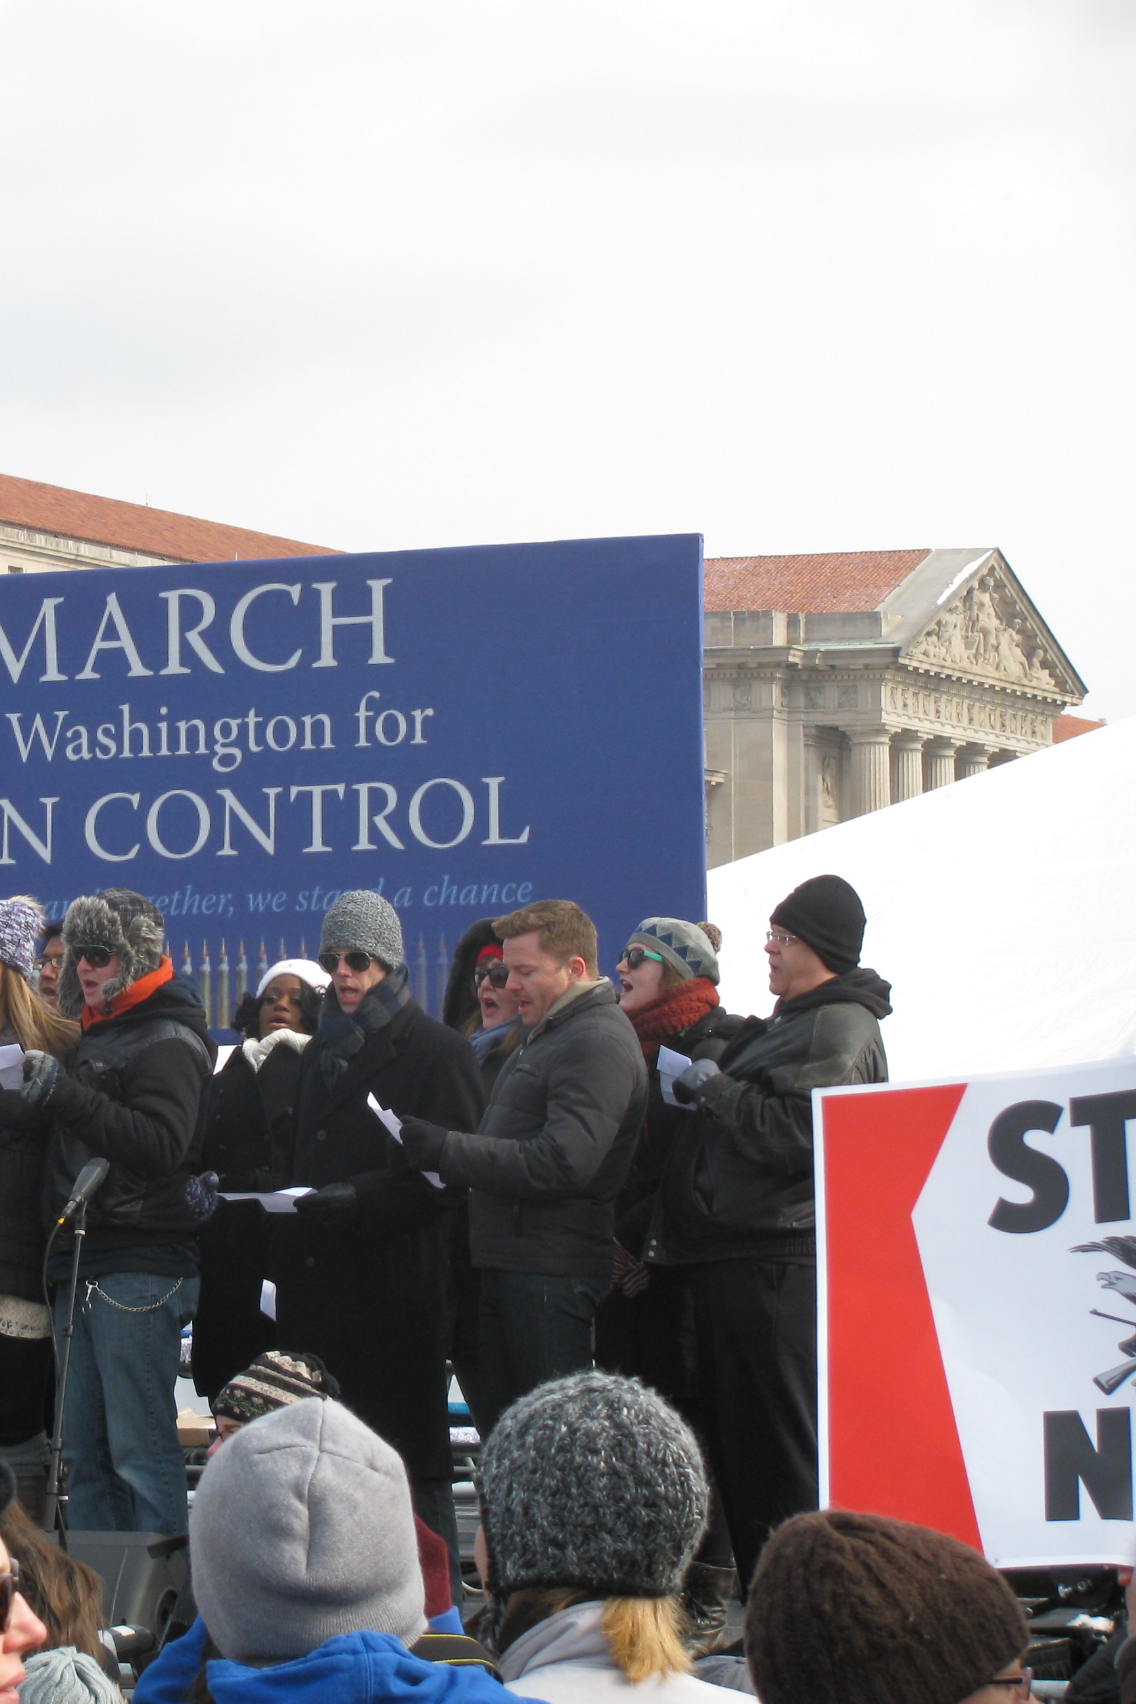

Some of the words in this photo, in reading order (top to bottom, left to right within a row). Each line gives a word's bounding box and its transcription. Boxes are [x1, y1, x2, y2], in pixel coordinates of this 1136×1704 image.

[6, 704, 335, 773] Washington
[355, 691, 434, 747] for
[84, 776, 531, 862] CONTROL
[247, 891, 288, 913] we
[393, 886, 413, 908] a
[423, 874, 534, 907] chance
[987, 1088, 1136, 1234] ST
[1043, 1406, 1133, 1522] N
